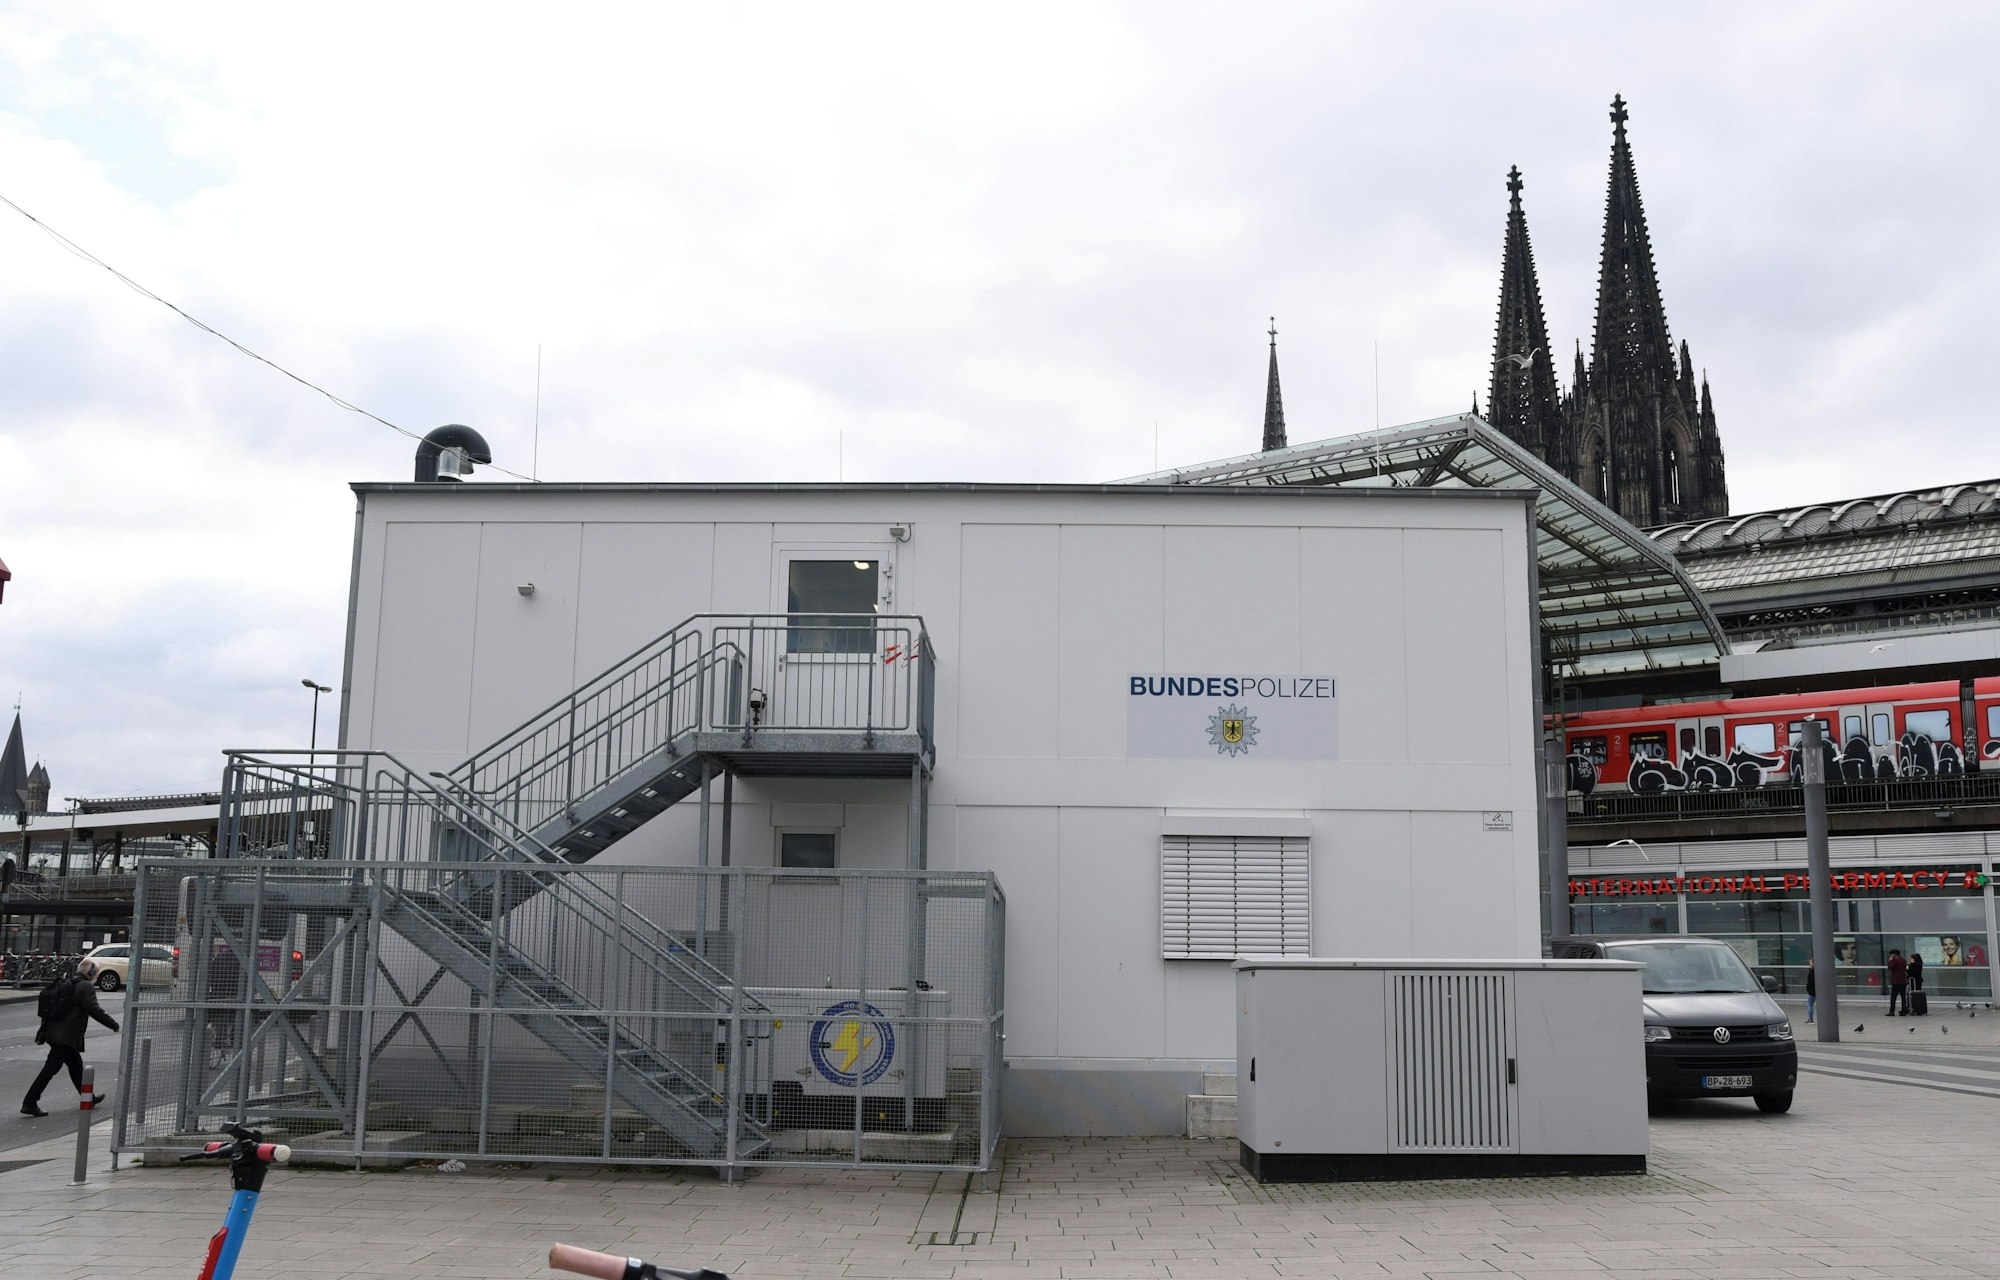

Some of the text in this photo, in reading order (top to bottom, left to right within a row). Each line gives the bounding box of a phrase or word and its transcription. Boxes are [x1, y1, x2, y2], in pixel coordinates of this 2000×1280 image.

[1130, 676, 1336, 698] BUNDESPOLIZEI
[1777, 722, 1785, 733] 2
[1614, 735, 1621, 745] 2
[1569, 875, 1772, 897] NTERNATIONAL
